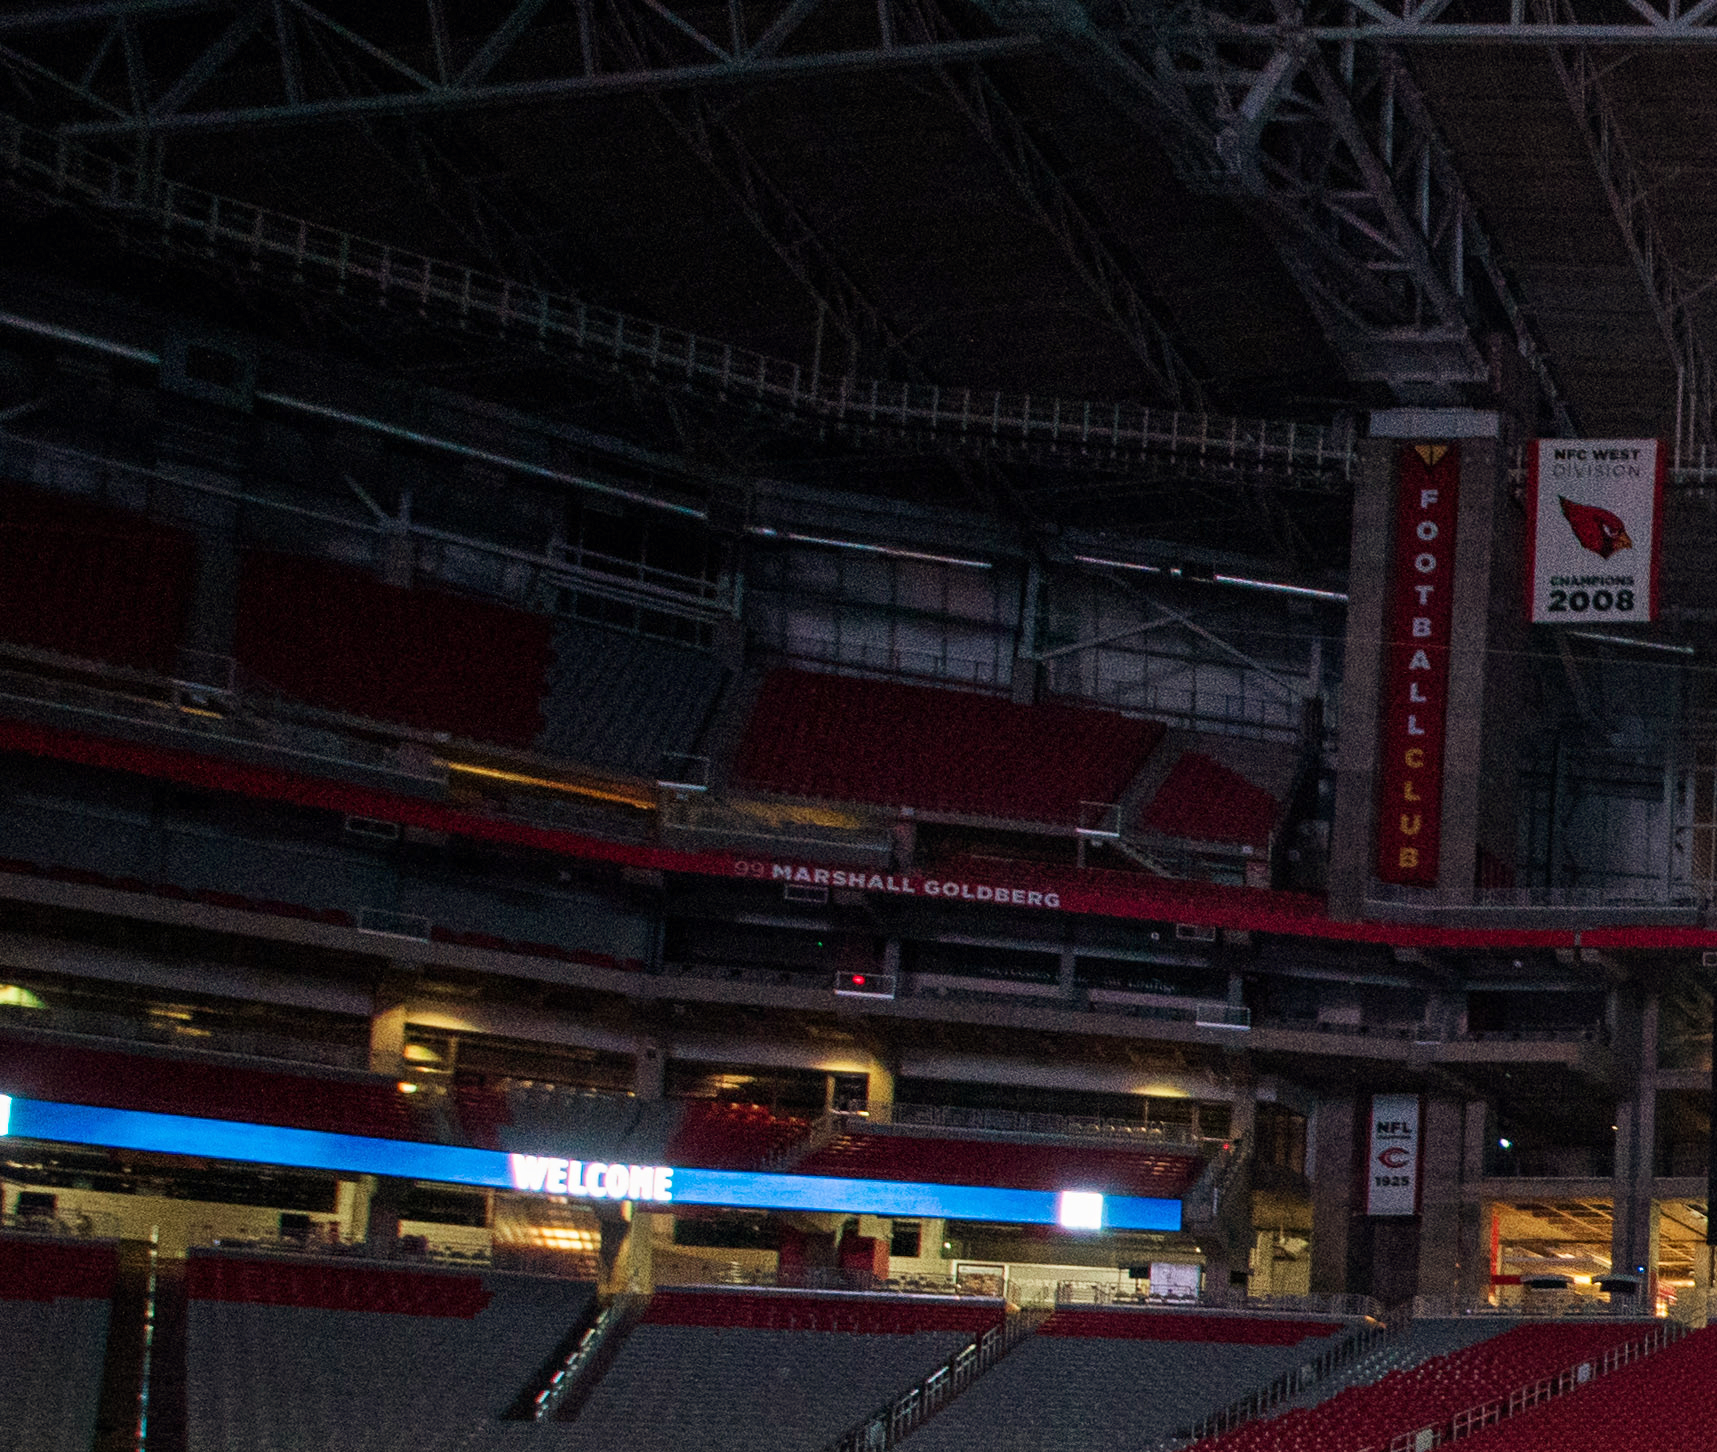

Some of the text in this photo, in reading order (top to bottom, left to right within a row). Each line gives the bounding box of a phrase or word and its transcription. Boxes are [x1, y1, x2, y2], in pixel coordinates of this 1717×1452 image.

[1554, 449, 1640, 461] NFC WEST
[1553, 464, 1641, 478] DIVISION
[1549, 575, 1634, 587] CHAMPIONS
[1548, 590, 1635, 612] 2008
[1399, 489, 1439, 868] FOOTBALL CLUB
[734, 860, 1061, 908] 99 MARSHALL GOLDBERG
[1376, 1122, 1412, 1133] NFL
[511, 1153, 674, 1201] WELCOME
[1375, 1176, 1410, 1187] 1925
